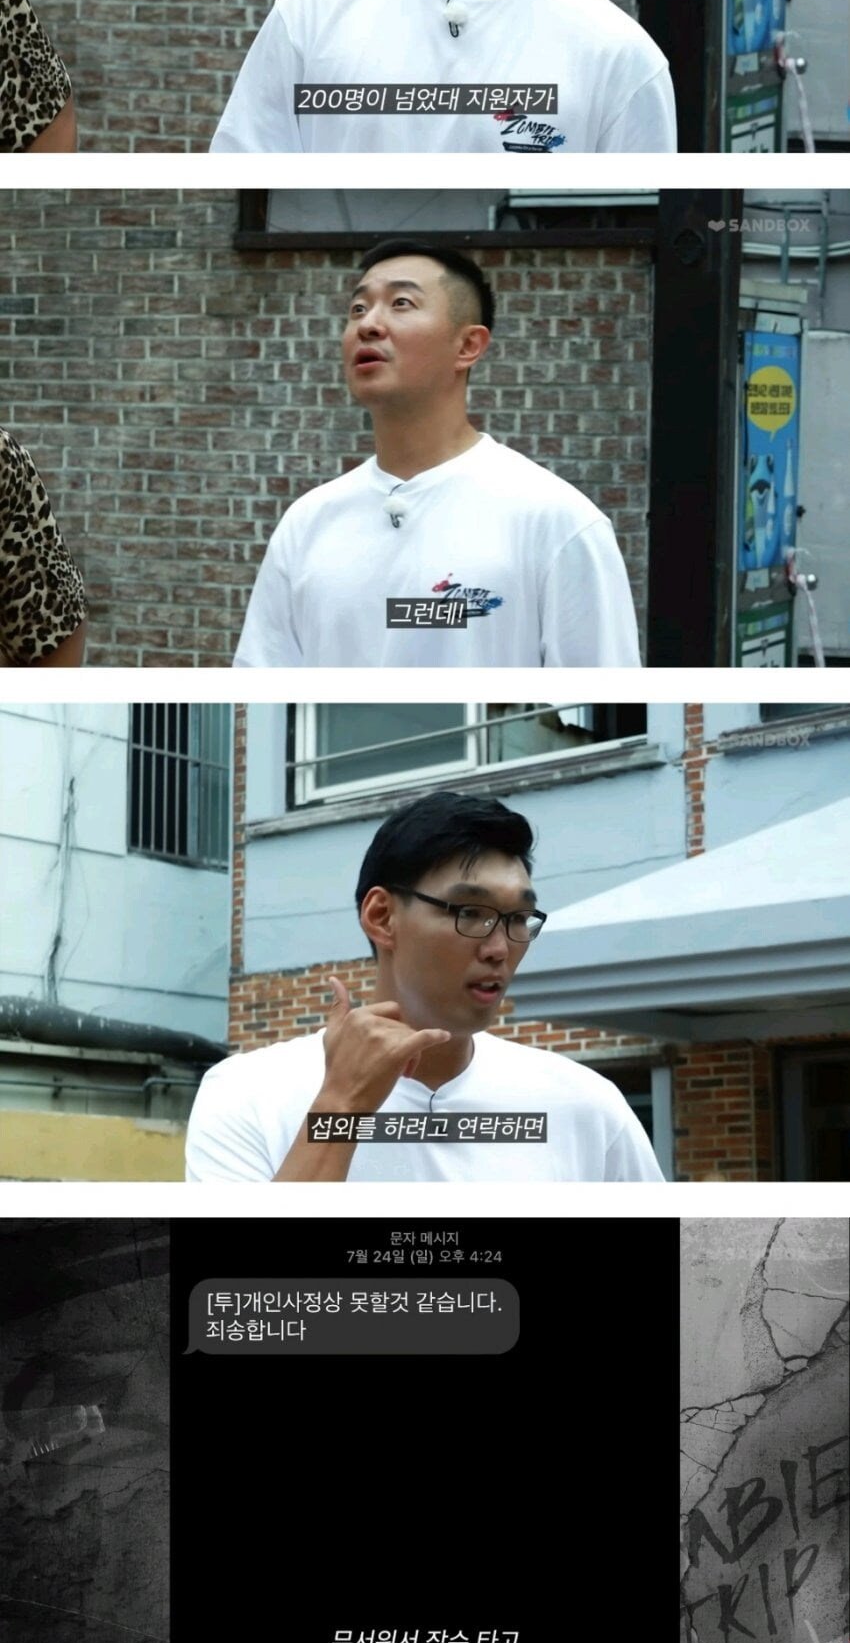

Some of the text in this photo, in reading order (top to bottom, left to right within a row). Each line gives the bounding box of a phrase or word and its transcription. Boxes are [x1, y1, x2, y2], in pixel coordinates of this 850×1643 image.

[390, 1231, 459, 1246] 문자 메시지
[346, 1248, 502, 1266] 7월 24일 (일) 오후 4:24
[207, 1291, 502, 1316] [투]개인사정상 못할것 같습니다.
[206, 1319, 307, 1342] 죄송합니다
